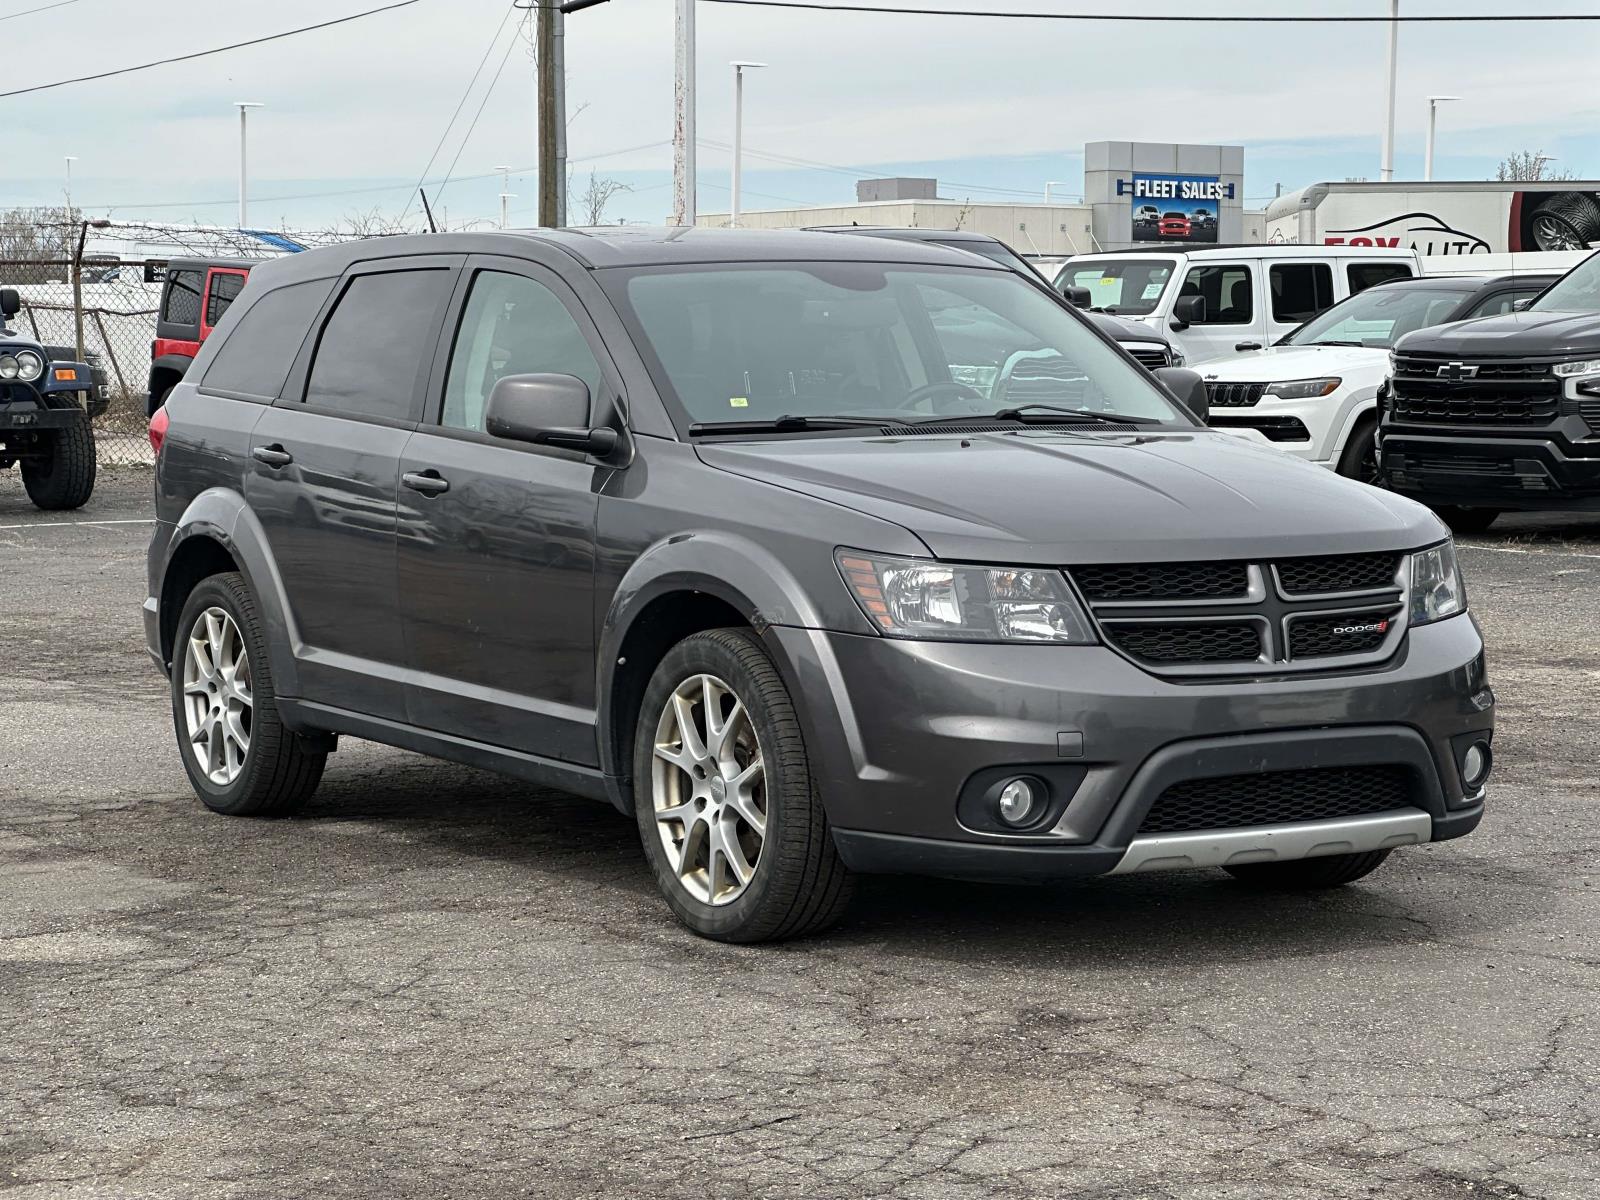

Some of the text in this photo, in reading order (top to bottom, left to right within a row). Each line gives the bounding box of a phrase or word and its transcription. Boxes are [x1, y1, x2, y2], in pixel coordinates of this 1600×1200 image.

[1135, 179, 1224, 200] FLEET SALES
[1333, 624, 1382, 634] DODGE
